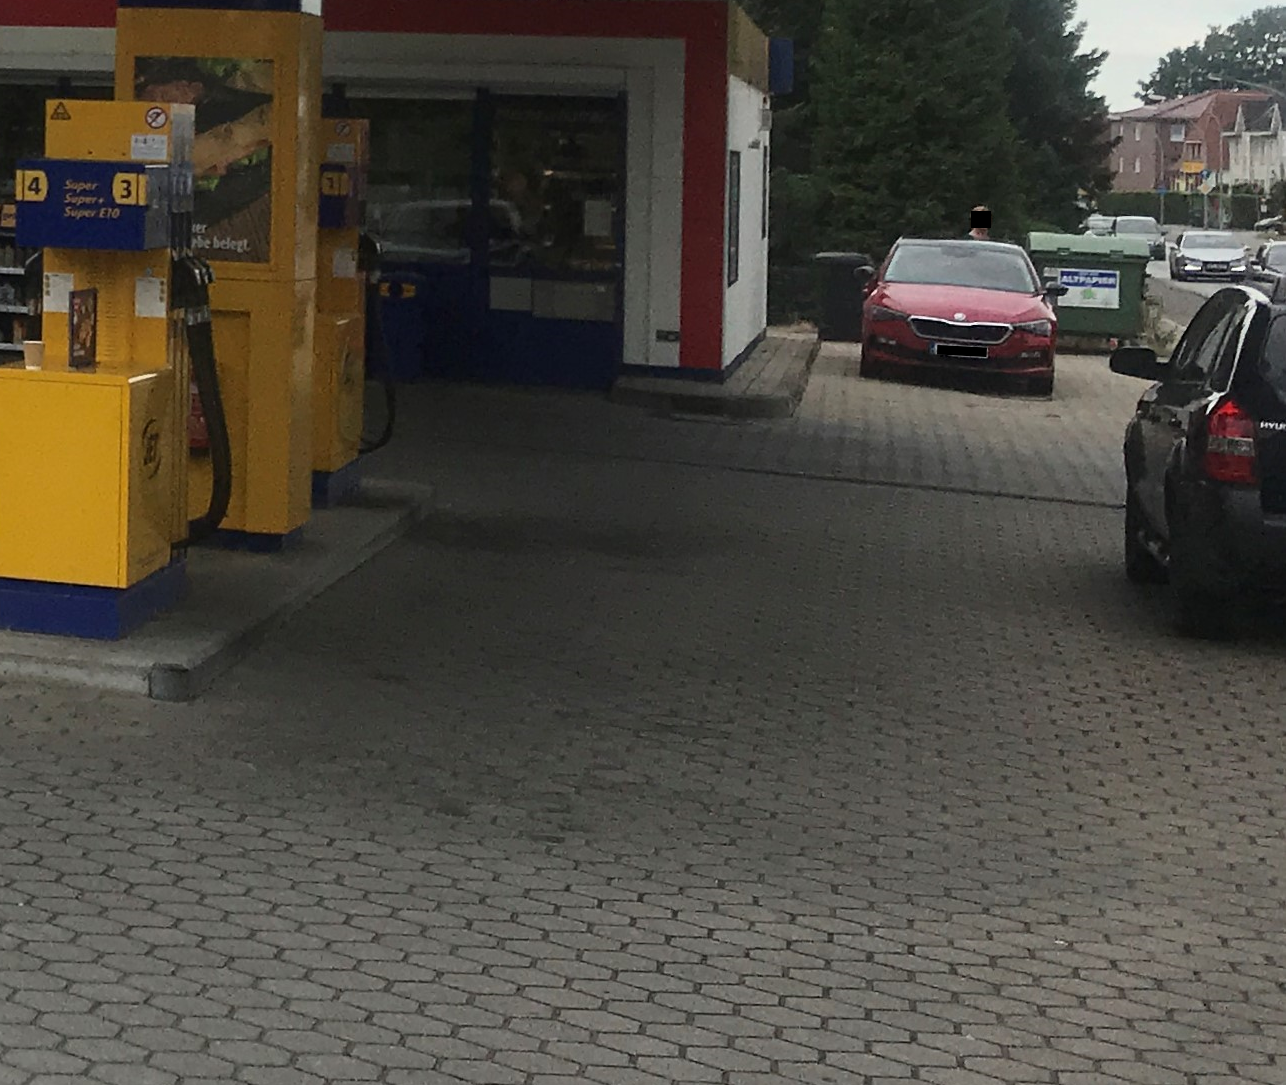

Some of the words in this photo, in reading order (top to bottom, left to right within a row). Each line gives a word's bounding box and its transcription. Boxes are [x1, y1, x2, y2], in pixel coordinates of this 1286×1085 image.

[27, 176, 42, 195] 4
[63, 179, 99, 193] Super
[120, 179, 132, 199] 3
[63, 207, 97, 221] Super
[99, 208, 120, 219] E10
